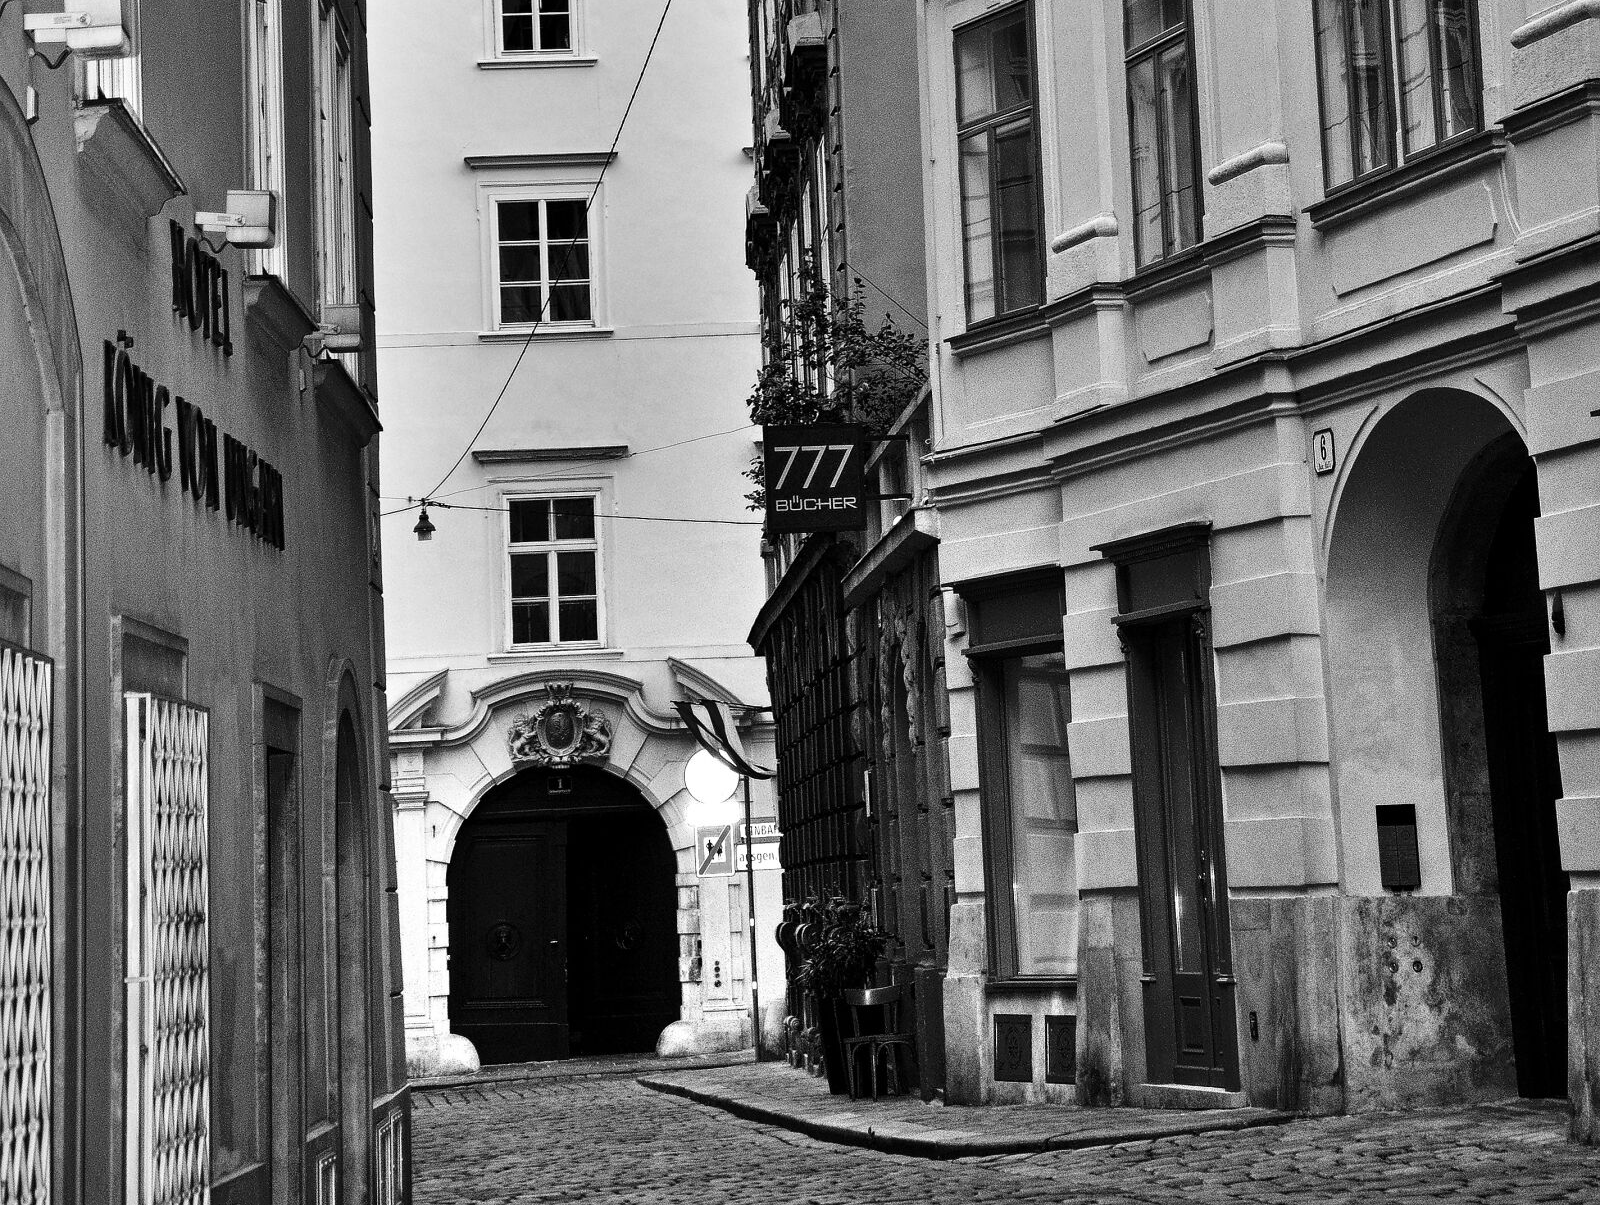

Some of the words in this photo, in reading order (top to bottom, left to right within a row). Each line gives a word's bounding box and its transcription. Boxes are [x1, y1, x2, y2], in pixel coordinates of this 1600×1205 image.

[169, 218, 233, 357] HOTEL
[1320, 434, 1327, 461] 6
[774, 444, 854, 490] 777
[775, 495, 858, 512] BÜCHER
[739, 852, 778, 864] asgen.
